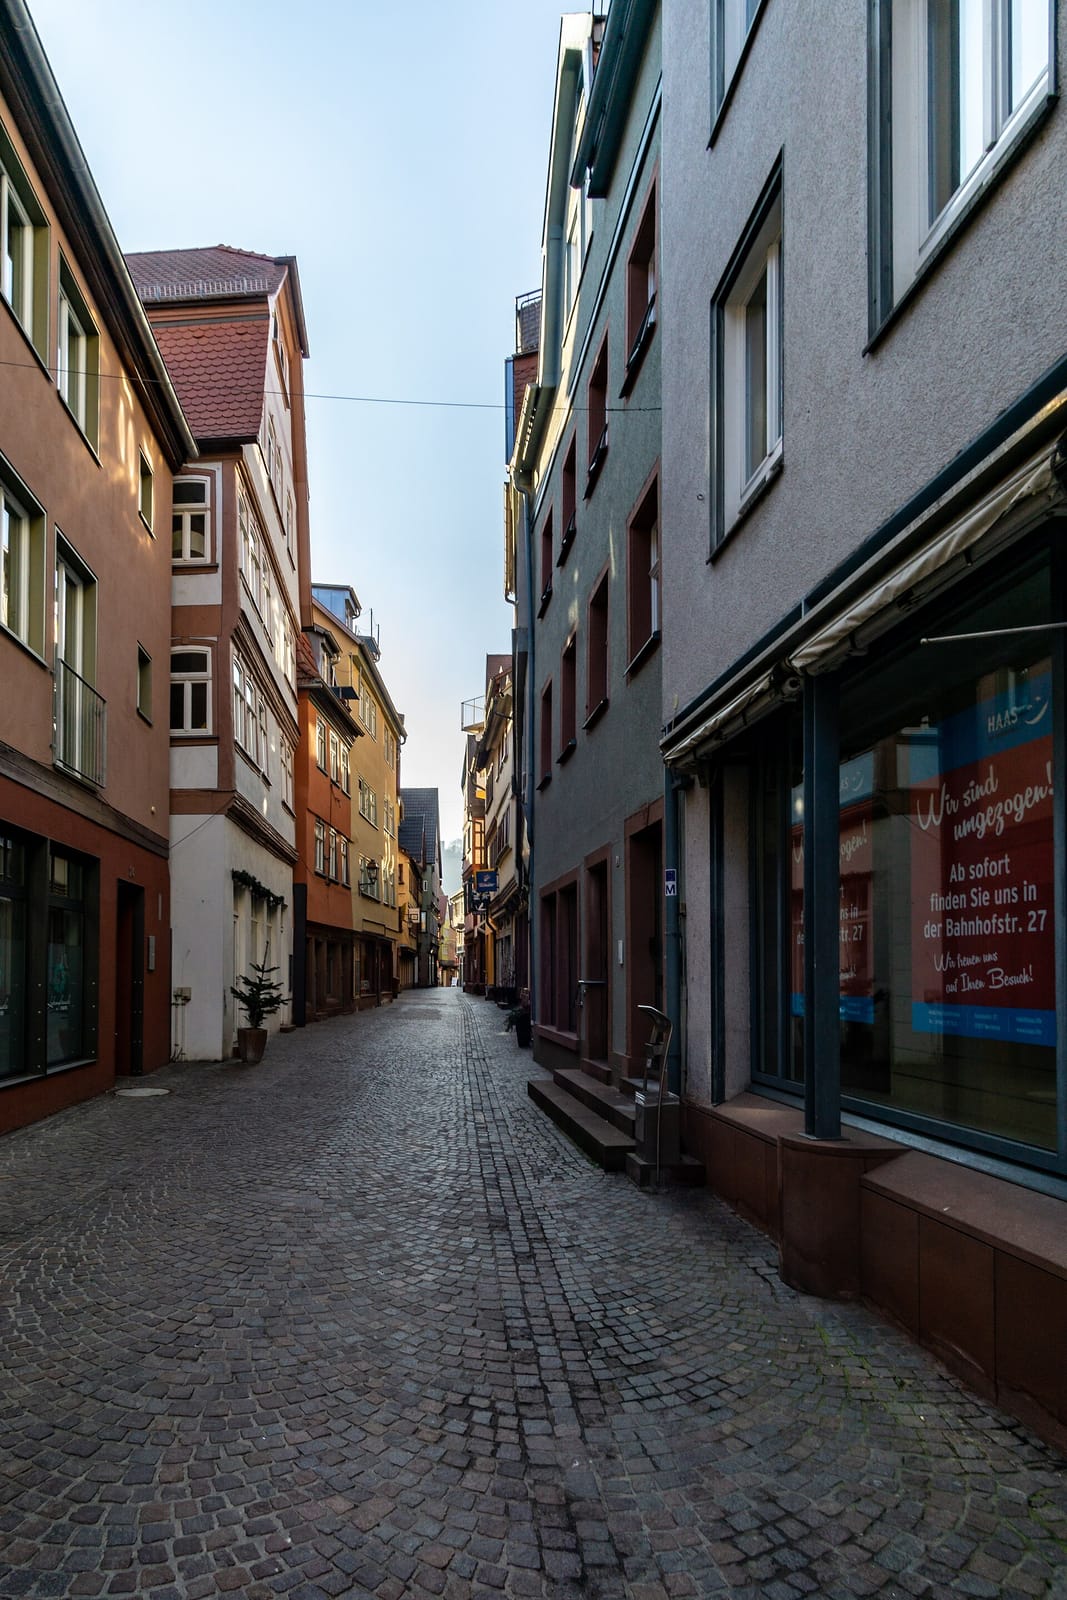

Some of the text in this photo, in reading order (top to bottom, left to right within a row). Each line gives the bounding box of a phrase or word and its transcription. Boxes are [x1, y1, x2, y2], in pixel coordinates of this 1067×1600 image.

[988, 707, 1018, 733] HAAS
[917, 765, 999, 830] Wir sind
[954, 760, 1055, 841] umgezogen!
[950, 853, 1010, 883] Ab sofort
[930, 880, 1037, 912] finden Sie uns in
[852, 924, 863, 942] 27
[924, 909, 1047, 939] der Bahnhofstr. 27
[933, 951, 999, 972] Wir freuen uns
[946, 964, 1034, 994] auf Ihren Besuch!
